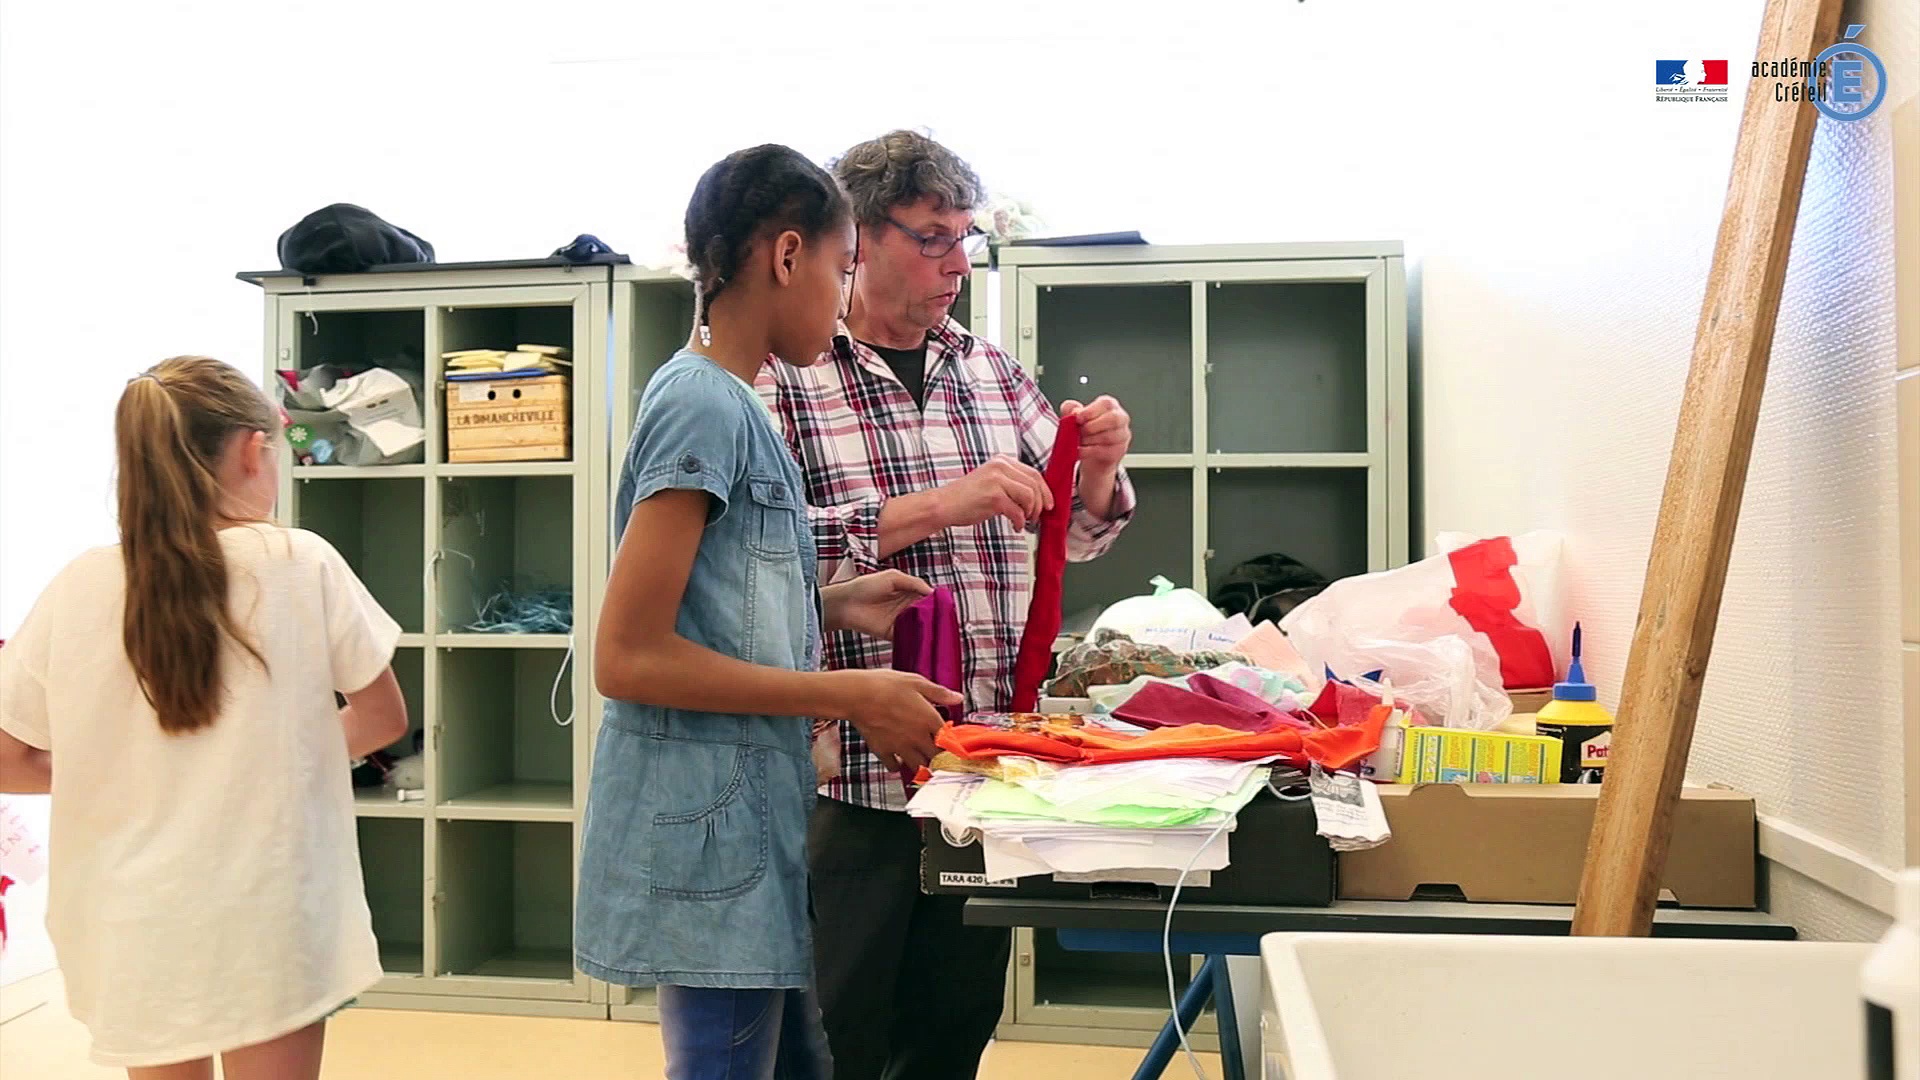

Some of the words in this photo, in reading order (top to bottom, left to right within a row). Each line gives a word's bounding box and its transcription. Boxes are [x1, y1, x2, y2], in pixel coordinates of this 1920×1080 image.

[457, 414, 471, 425] LA
[942, 874, 965, 884] TARA
[966, 875, 983, 885] 420
